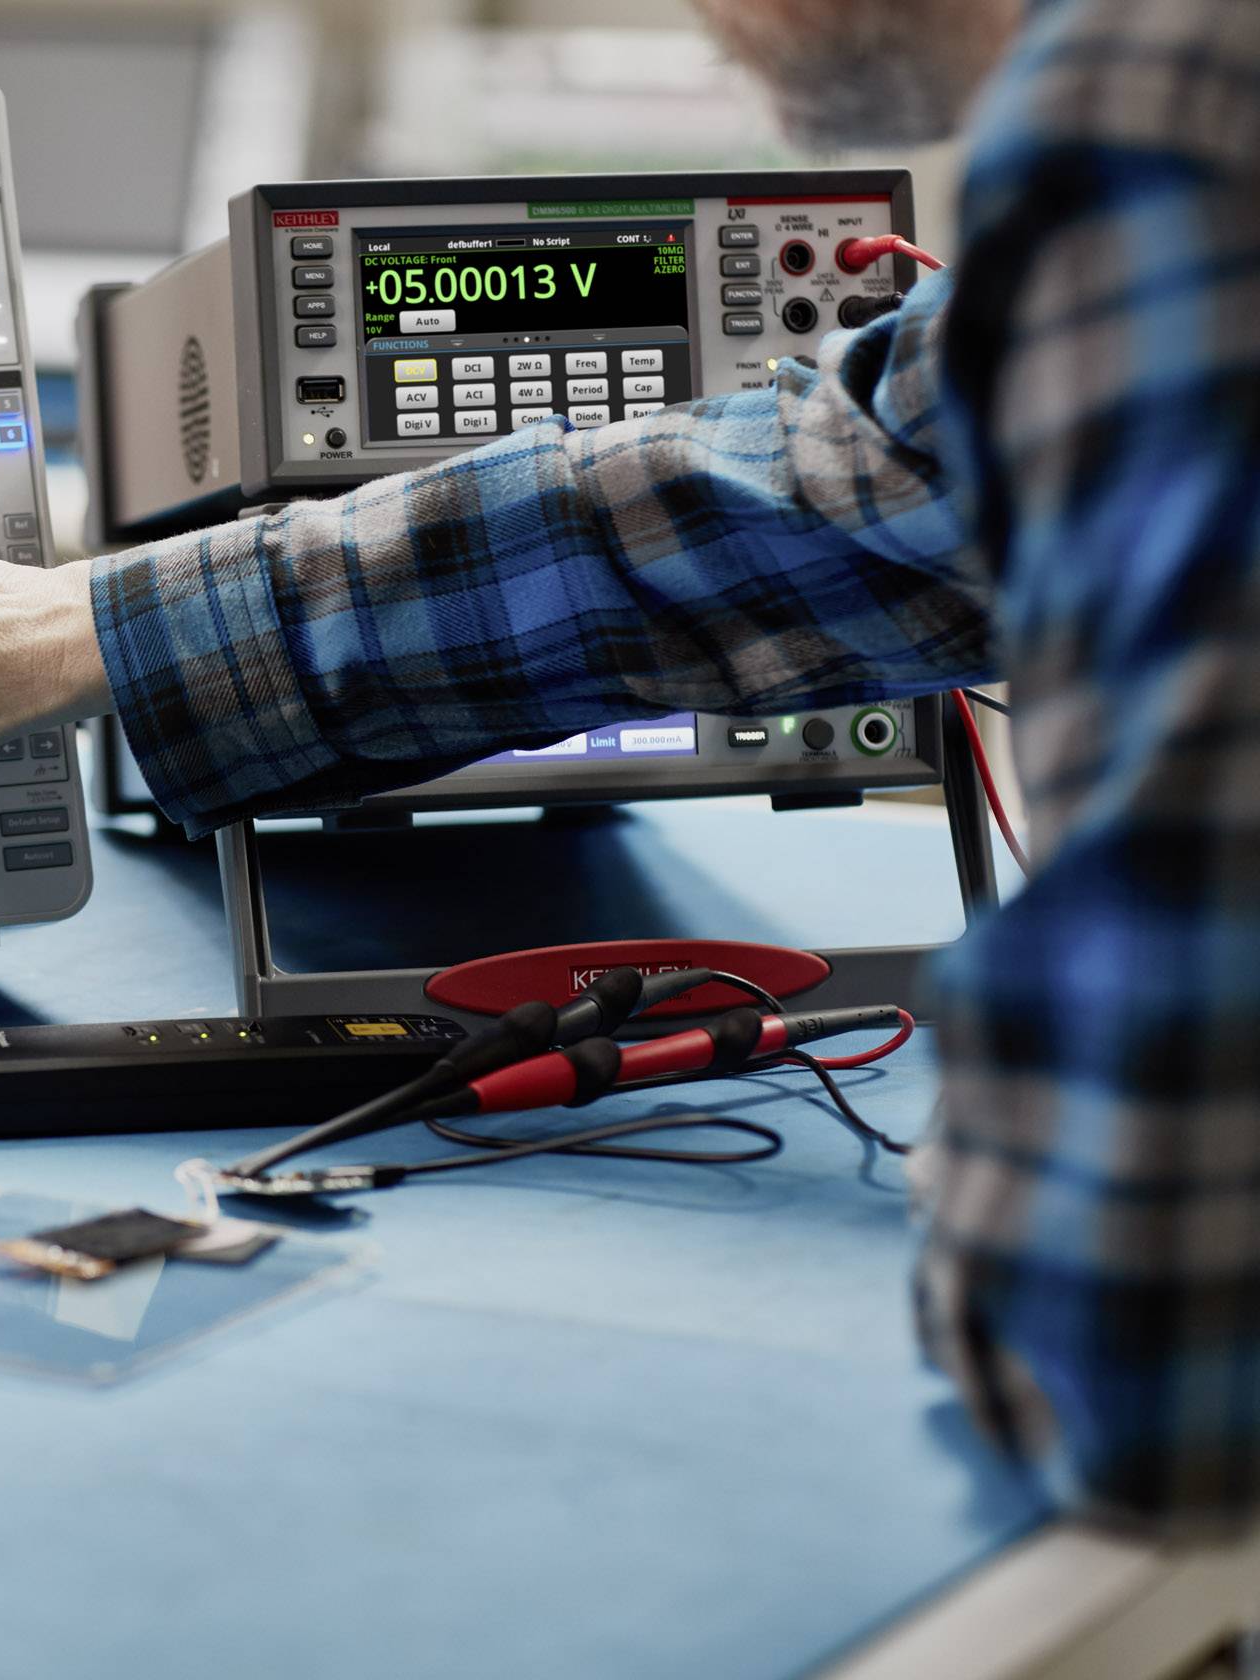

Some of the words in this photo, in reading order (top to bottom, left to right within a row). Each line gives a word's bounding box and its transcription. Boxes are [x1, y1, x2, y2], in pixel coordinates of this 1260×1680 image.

[276, 213, 338, 226] KEITHLEY
[837, 217, 863, 226] INPUT
[616, 235, 640, 244] CONT
[730, 232, 753, 241] ENTER
[303, 242, 323, 250] HOME
[447, 239, 493, 250] defbuffer1
[533, 237, 544, 246] No
[546, 236, 571, 248] Script
[368, 243, 391, 252] Local
[657, 246, 684, 255] 10MΩ
[364, 257, 379, 266] DC
[380, 255, 429, 265] VOLTAGE:
[431, 255, 457, 264] Front
[654, 256, 685, 265] FILTER
[654, 265, 686, 274] AZERO
[735, 261, 751, 270] EXIT
[305, 272, 325, 280] MENU
[365, 264, 558, 305] +05.00013
[569, 262, 597, 298] V
[727, 290, 761, 299] FUNCTION
[365, 313, 395, 323] Range
[415, 317, 440, 326] Auto
[731, 320, 760, 328] TRIGGER
[365, 326, 383, 334] 10V
[309, 332, 327, 340] HELP
[373, 340, 429, 350] FUNCTIONS
[576, 359, 597, 369] Freq
[630, 357, 656, 366] Temp
[736, 362, 761, 370] FRONT
[464, 363, 482, 372] DCI
[572, 386, 603, 395] Period
[634, 384, 652, 392] Cap
[406, 393, 427, 402] ACV
[465, 390, 483, 399] ACI
[575, 412, 603, 422] Diode
[633, 410, 652, 419] Rat
[404, 420, 424, 431] Digi
[424, 419, 432, 428] V
[320, 451, 353, 459] POWER
[590, 736, 616, 748] Limit
